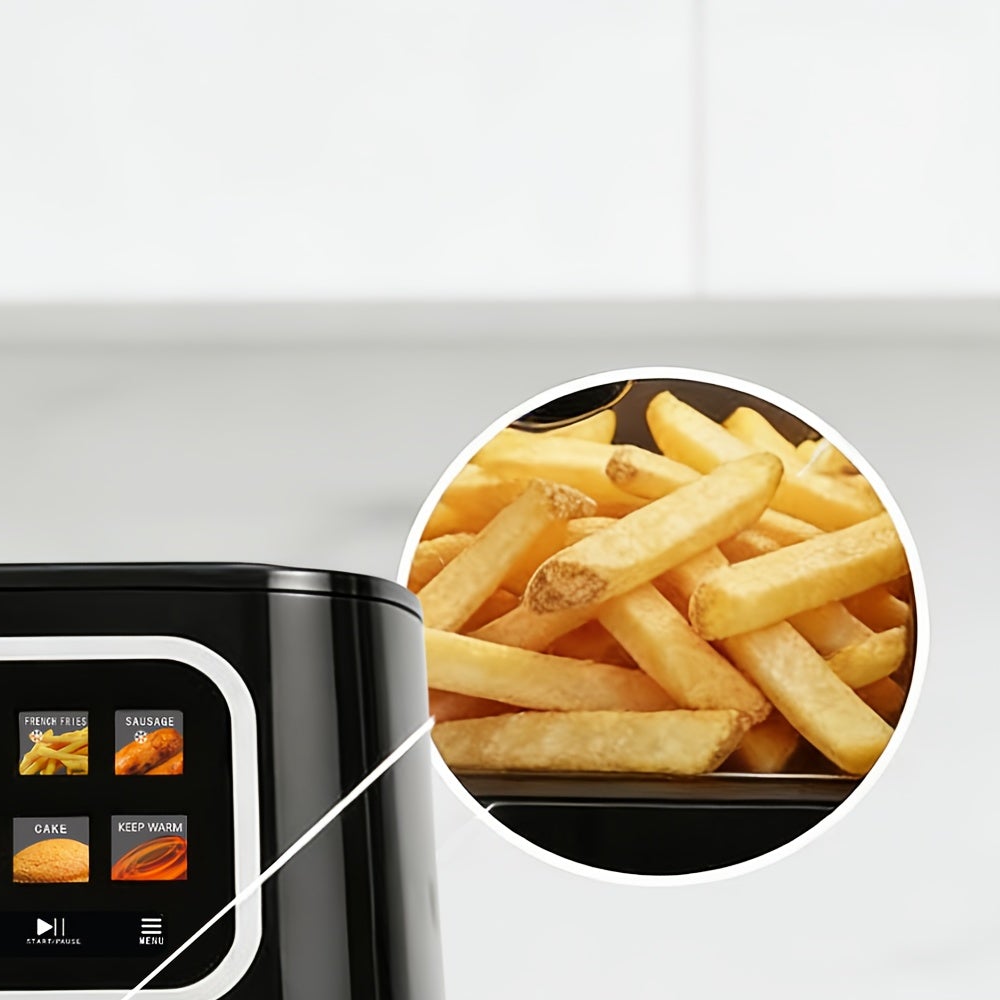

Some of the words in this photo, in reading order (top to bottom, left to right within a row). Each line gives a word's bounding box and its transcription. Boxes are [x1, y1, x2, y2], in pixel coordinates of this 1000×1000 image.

[24, 716, 57, 726] FRENCH
[60, 716, 87, 726] FRIES
[125, 716, 174, 726] SAUSAGE
[34, 823, 67, 834] CAKE
[118, 822, 145, 833] KEEP
[148, 822, 183, 833] WARM
[139, 936, 164, 945] MENU
